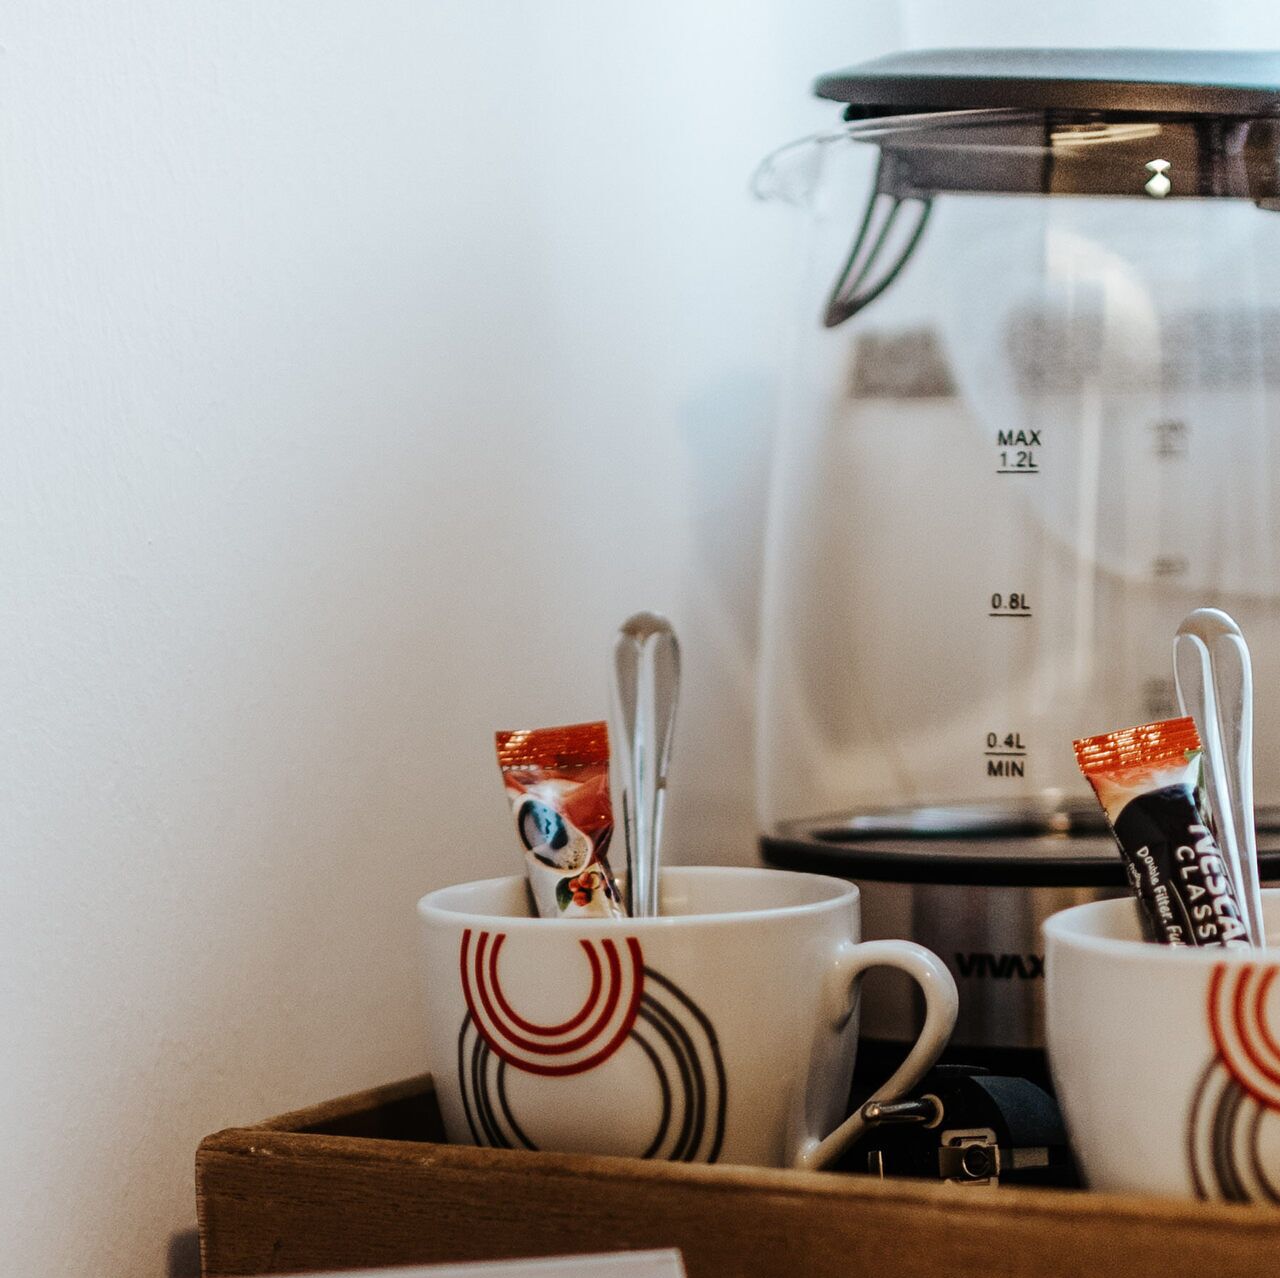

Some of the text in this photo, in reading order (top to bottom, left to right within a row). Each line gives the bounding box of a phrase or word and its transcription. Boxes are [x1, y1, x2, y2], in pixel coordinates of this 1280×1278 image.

[997, 429, 1041, 446] MAX
[1000, 450, 1039, 468] 1.2L
[991, 592, 1031, 610] 0.8L
[986, 731, 1026, 749] 0.4L
[987, 759, 1024, 777] MIN
[1136, 845, 1160, 886] Double
[955, 952, 1045, 979] VIVAX
